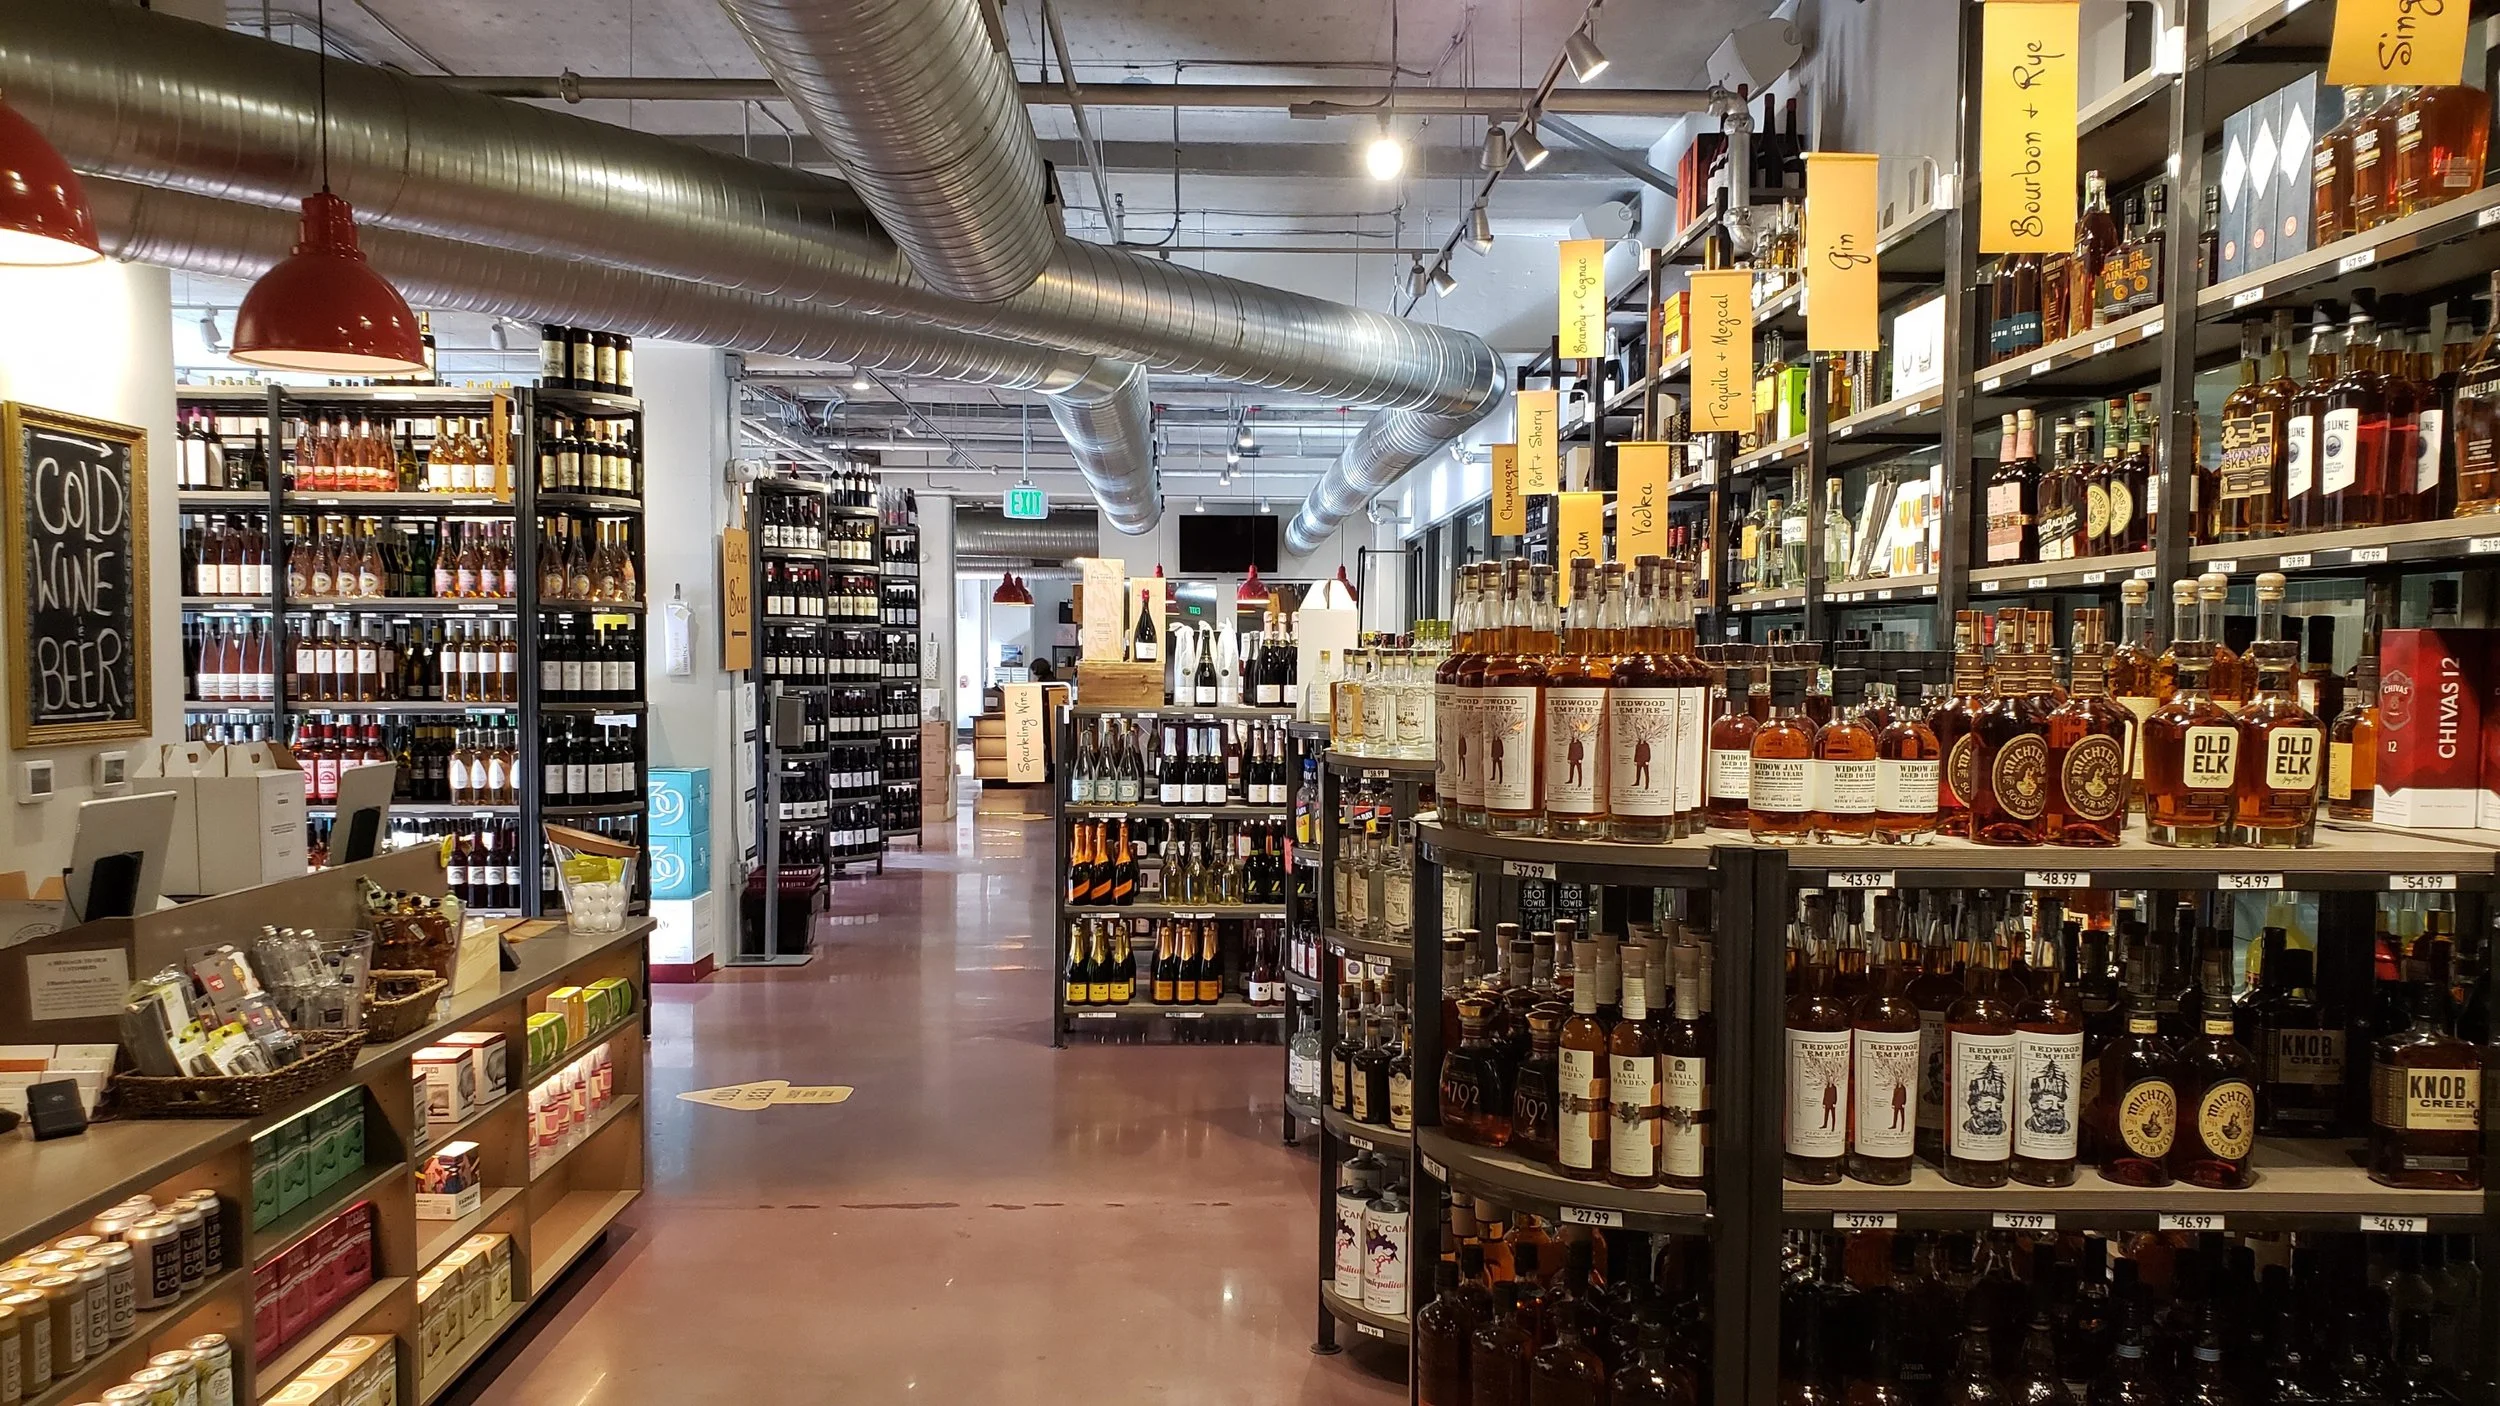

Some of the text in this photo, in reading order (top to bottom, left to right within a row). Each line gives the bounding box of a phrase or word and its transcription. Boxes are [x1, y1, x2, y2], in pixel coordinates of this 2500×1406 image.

[2012, 39, 2066, 91] Rye
[2010, 130, 2044, 238] Bourbon
[1828, 232, 1871, 271] Gin
[1573, 257, 1596, 291] Cognac
[1714, 292, 1742, 347] Mezcal
[1573, 314, 1595, 354] Brandy
[1709, 366, 1733, 427] Tequila
[1528, 409, 1552, 447] Sherry
[1529, 463, 1545, 488] Port
[1500, 458, 1519, 521] Champagne
[35, 457, 123, 543] COLD
[1011, 491, 1042, 516] EXIT
[33, 538, 115, 617] WINE
[729, 579, 747, 617] Beer
[37, 628, 123, 712] BEER
[2384, 684, 2409, 695] CHIVAS
[2438, 657, 2460, 759] CHIVAS 12
[1015, 691, 1039, 773] Sparkling Wine
[2194, 735, 2230, 754] OLD
[2278, 736, 2313, 755] OLD
[2388, 741, 2397, 752] 12
[1754, 762, 1781, 771] WIDOW
[2193, 755, 2229, 774] ELK
[2275, 756, 2312, 775] ELK
[648, 782, 685, 826] 39
[2006, 789, 2027, 808] SOUR
[2074, 789, 2096, 808] SOUR
[650, 846, 686, 890] 39
[1512, 862, 1545, 878] $37.99
[1841, 873, 1882, 886] $43.99
[2037, 872, 2077, 885] $48.99
[2230, 875, 2270, 888] $54.99
[2402, 875, 2443, 889] $54.99
[1523, 889, 1546, 899] SHOT
[1523, 899, 1546, 907] TOWER
[1560, 890, 1582, 899] SHOT
[1560, 899, 1583, 907] TOWER
[1801, 1043, 1848, 1051] REDWOOD
[1807, 1050, 1845, 1058] EMPIRE
[1870, 1043, 1917, 1051] REDWOOD
[2030, 1045, 2080, 1053] REDWOOD
[2281, 1034, 2333, 1057] KNOB
[2290, 1057, 2341, 1065] CREEK
[1617, 1072, 1642, 1080] BASIL
[1669, 1072, 1694, 1080] BASIL
[1448, 1080, 1480, 1109] 1792
[2410, 1075, 2466, 1099] KNOB
[1516, 1094, 1548, 1125] 1792
[2420, 1099, 2476, 1108] CREEK
[2126, 1129, 2173, 1153] BOURBON
[1572, 1208, 1609, 1224] $27.99
[1845, 1213, 1884, 1227] $37.99
[2004, 1213, 2043, 1227] $37.99
[2171, 1214, 2211, 1228] $46.99
[2374, 1216, 2414, 1232] $46.99
